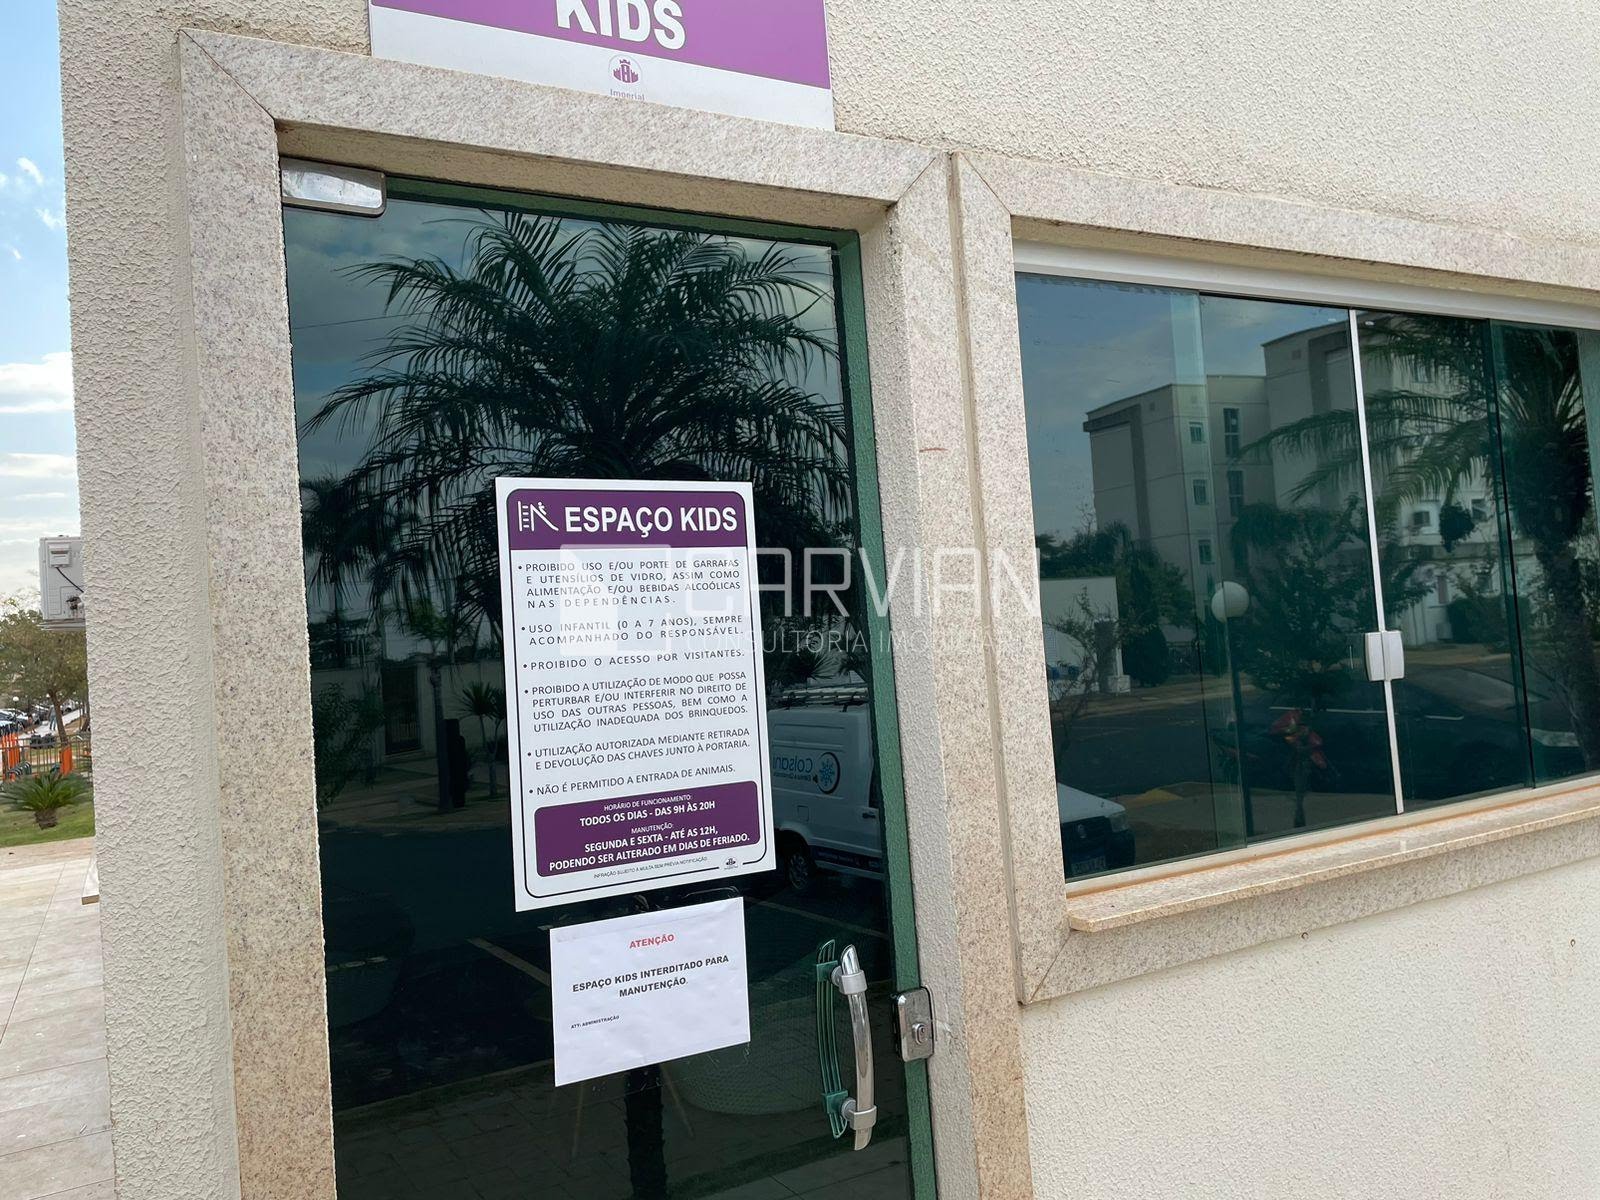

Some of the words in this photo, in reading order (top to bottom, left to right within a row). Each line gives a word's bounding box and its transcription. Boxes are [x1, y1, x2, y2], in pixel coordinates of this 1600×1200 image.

[557, 0, 686, 49] KIDS
[565, 506, 673, 537] ESPAÇO
[680, 507, 738, 531] KIDS
[525, 563, 575, 572] PROIBIDO
[582, 562, 602, 571] USO
[609, 561, 633, 570] E/OU
[640, 561, 669, 569] PORTE
[676, 560, 687, 568] DE
[693, 560, 739, 568] GARRAFAS
[527, 576, 532, 584] E
[540, 573, 603, 583] UTENSÍLIOS
[611, 574, 623, 582] DE
[631, 572, 666, 582] VIDRO,
[672, 572, 703, 580] ASSIM
[710, 571, 739, 579] COMO
[527, 585, 601, 597] ALIMENTAÇÃO
[608, 585, 633, 594] E/OU
[640, 583, 679, 592] BEBIDAS
[685, 580, 740, 591] ALCOÓLICAS
[528, 600, 555, 609] NAS
[564, 596, 676, 607] DEPENDÊNCIAS.
[529, 624, 552, 633] USO
[560, 621, 610, 631] INFANTIL
[617, 620, 628, 630] (0
[661, 618, 697, 627] ANOS),
[703, 615, 742, 624] SEMPRE
[529, 633, 628, 645] ACOMPANHADO
[637, 631, 652, 640] DO
[661, 626, 743, 638] RESPONSÁVEL.
[531, 659, 587, 670] PROIBIDO
[594, 658, 602, 666] O
[609, 654, 650, 665] ACESSO
[657, 653, 678, 661] POR
[684, 649, 744, 659] VISITANTES.
[532, 684, 581, 695] PROIBIDO
[582, 683, 589, 691] A
[592, 677, 646, 690] UTILIZAÇÃO
[649, 678, 661, 686] DE
[663, 675, 693, 685] MODO
[695, 674, 714, 683] QUE
[719, 671, 746, 681] POSSA
[532, 695, 590, 708] PERTURBAR
[595, 693, 620, 702] E/OU
[624, 689, 675, 700] INTERFERIR
[680, 687, 694, 695] NO
[698, 684, 731, 694] DIREITO
[735, 683, 746, 691] DE
[533, 711, 554, 720] USO
[562, 708, 581, 717] DAS
[588, 705, 627, 715] OUTRAS
[633, 701, 675, 711] PESSOAS,
[682, 698, 701, 706] BEM
[708, 695, 735, 705] COMO
[534, 718, 591, 732] UTILIZAÇÃO
[597, 712, 659, 726] INADEQUADA
[665, 710, 684, 720] DOS
[689, 705, 747, 718] BRINQUEDOS.
[535, 743, 592, 758] UTILIZAÇÃO
[596, 737, 656, 751] AUTORIZADA
[658, 732, 704, 745] MEDIANTE
[708, 728, 750, 740] RETIRADA
[536, 762, 541, 770] E
[544, 753, 604, 769] DEVOLUÇÃO
[607, 753, 626, 763] DAS
[628, 749, 663, 760] CHAVES
[665, 745, 695, 756] JUNTO
[697, 743, 704, 752] À
[706, 739, 750, 751] PORTARIA.
[537, 783, 559, 795] NÃO
[562, 782, 567, 791] É
[571, 777, 624, 791] PERMITIDO
[627, 776, 633, 784] A
[636, 772, 679, 783] ENTRADA
[681, 769, 693, 778] DE
[695, 764, 735, 776] ANIMAIS.
[580, 815, 611, 827] TODOS
[613, 813, 625, 823] OS
[627, 809, 647, 821] DIAS
[655, 807, 672, 817] DAS
[674, 804, 685, 814] 9H
[687, 801, 698, 812] ÀS
[699, 801, 715, 810] 20H
[604, 802, 631, 811] HORÁRIO
[641, 794, 691, 806] FUNCIONAMENTO:
[585, 838, 628, 852] SEGUNDA
[630, 836, 635, 845] E
[637, 833, 663, 844] SEXTA
[670, 829, 685, 839] ATÉ
[700, 826, 718, 836] 12H,
[631, 822, 674, 834] MANUTENÇÃO:
[550, 856, 596, 871] PODENDO
[598, 853, 614, 863] SER
[616, 846, 661, 861] ALTERADO
[663, 844, 677, 854] EM
[679, 840, 698, 852] DIAS
[700, 839, 711, 848] DE
[713, 833, 750, 846] FERIADO.
[629, 934, 674, 949] ATENÇÃO
[573, 978, 611, 992] ESPAÇO
[615, 973, 638, 984] KIDS
[640, 961, 702, 978] INTERDITADO
[705, 955, 729, 966] PARA
[619, 977, 688, 997] MANUTENÇÃO.
